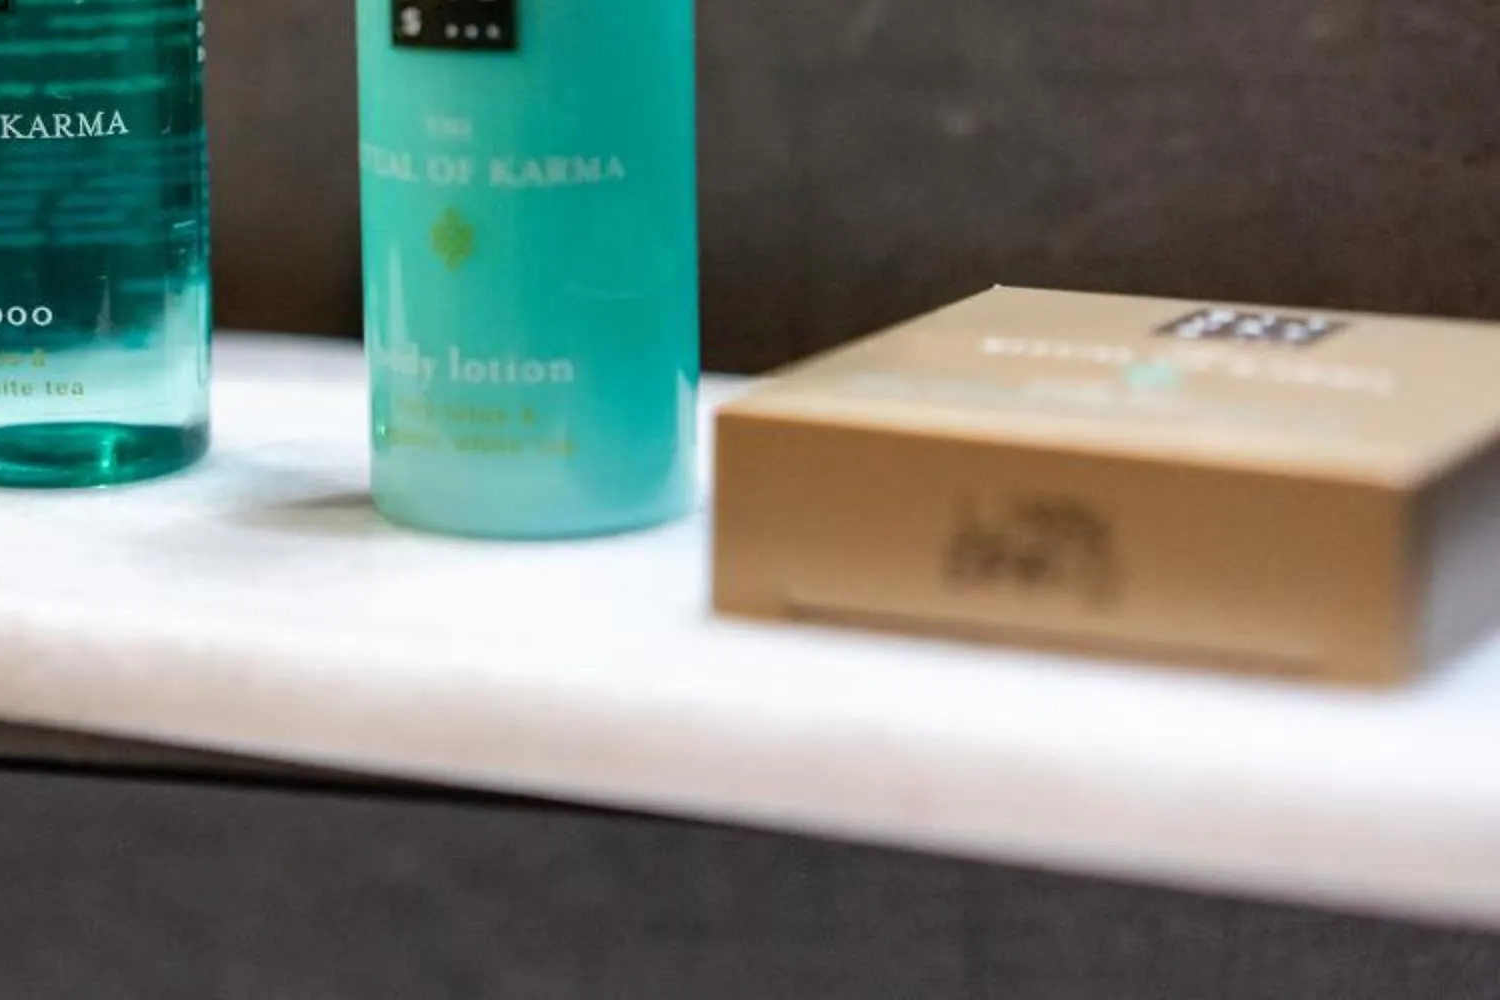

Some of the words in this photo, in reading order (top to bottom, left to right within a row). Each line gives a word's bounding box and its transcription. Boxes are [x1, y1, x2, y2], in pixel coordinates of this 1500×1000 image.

[426, 155, 471, 186] OF
[488, 153, 626, 188] KARMA
[448, 343, 575, 384] lotion
[44, 378, 85, 398] tea
